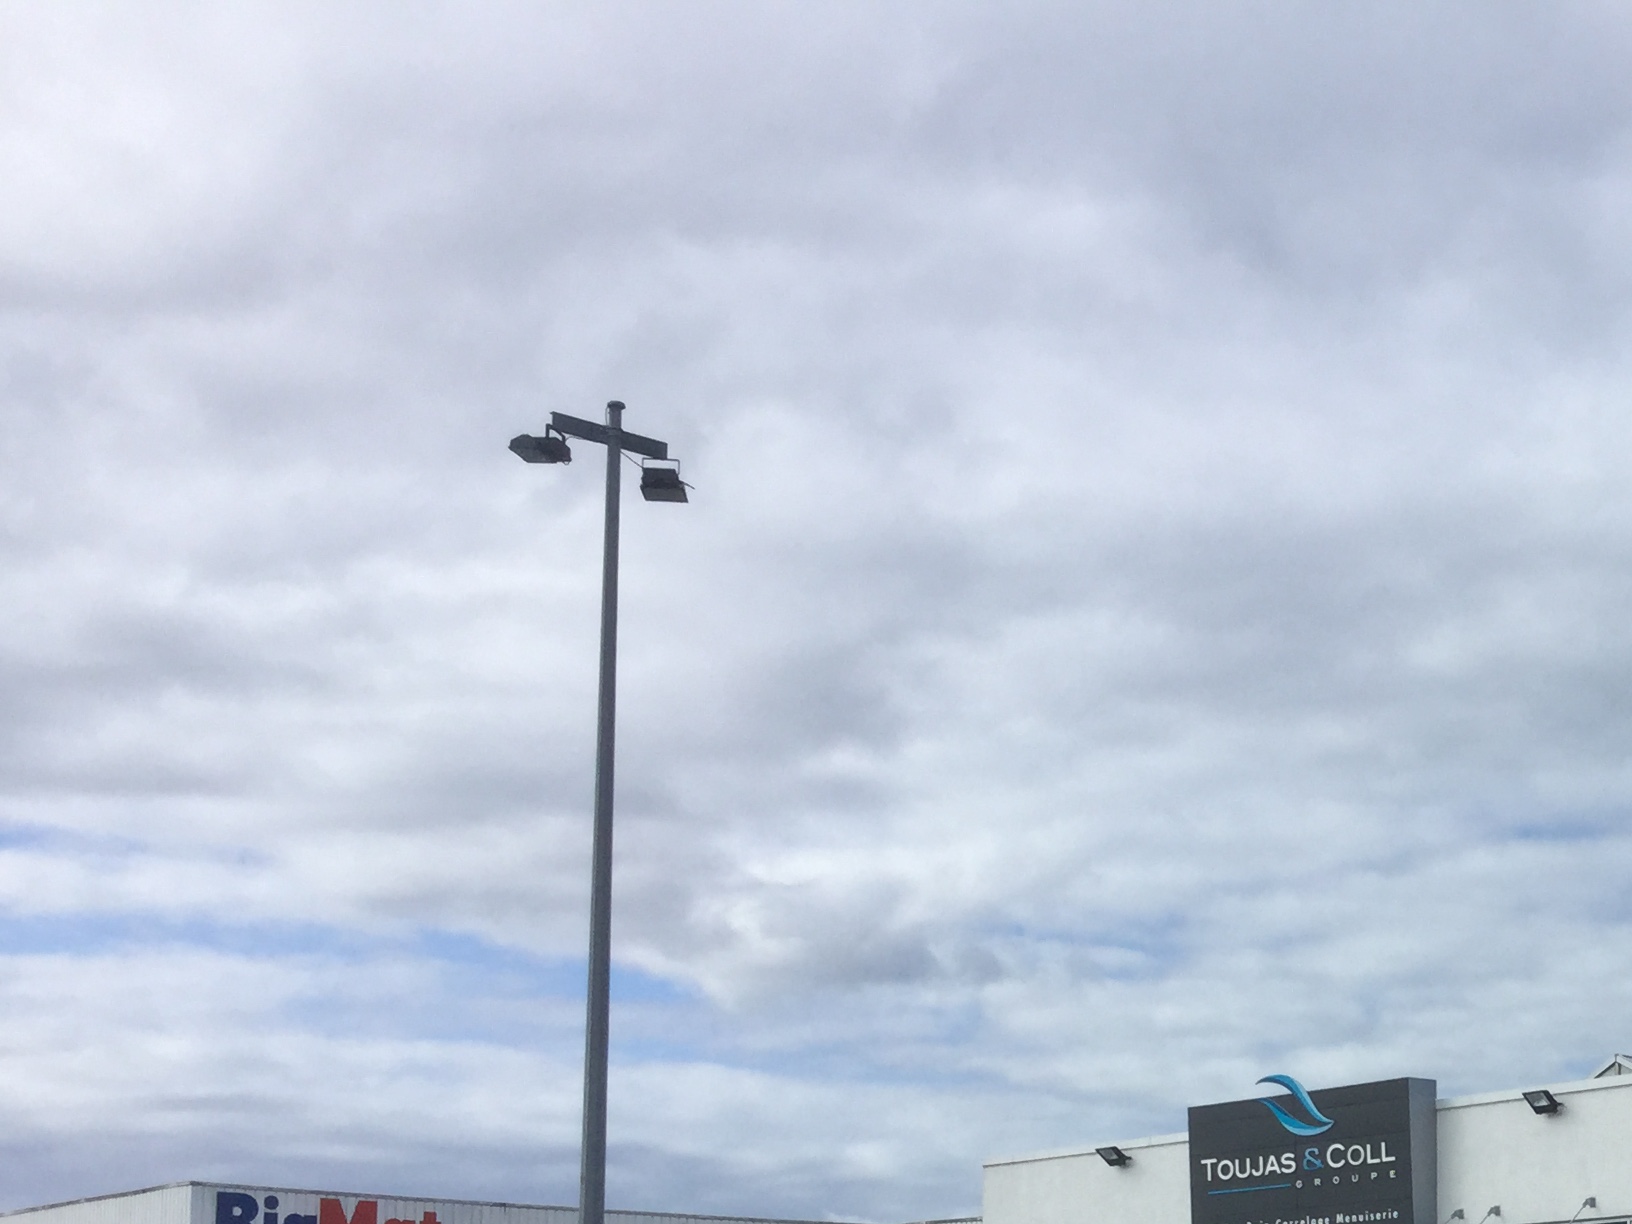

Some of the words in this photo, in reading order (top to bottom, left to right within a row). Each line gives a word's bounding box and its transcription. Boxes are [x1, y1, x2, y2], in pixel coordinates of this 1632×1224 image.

[1201, 1152, 1297, 1181] TOUJAS
[1302, 1147, 1325, 1171] &
[1326, 1142, 1396, 1169] COLL
[1295, 1170, 1397, 1189] GROUPE
[1336, 1208, 1399, 1224] Menuiserie
